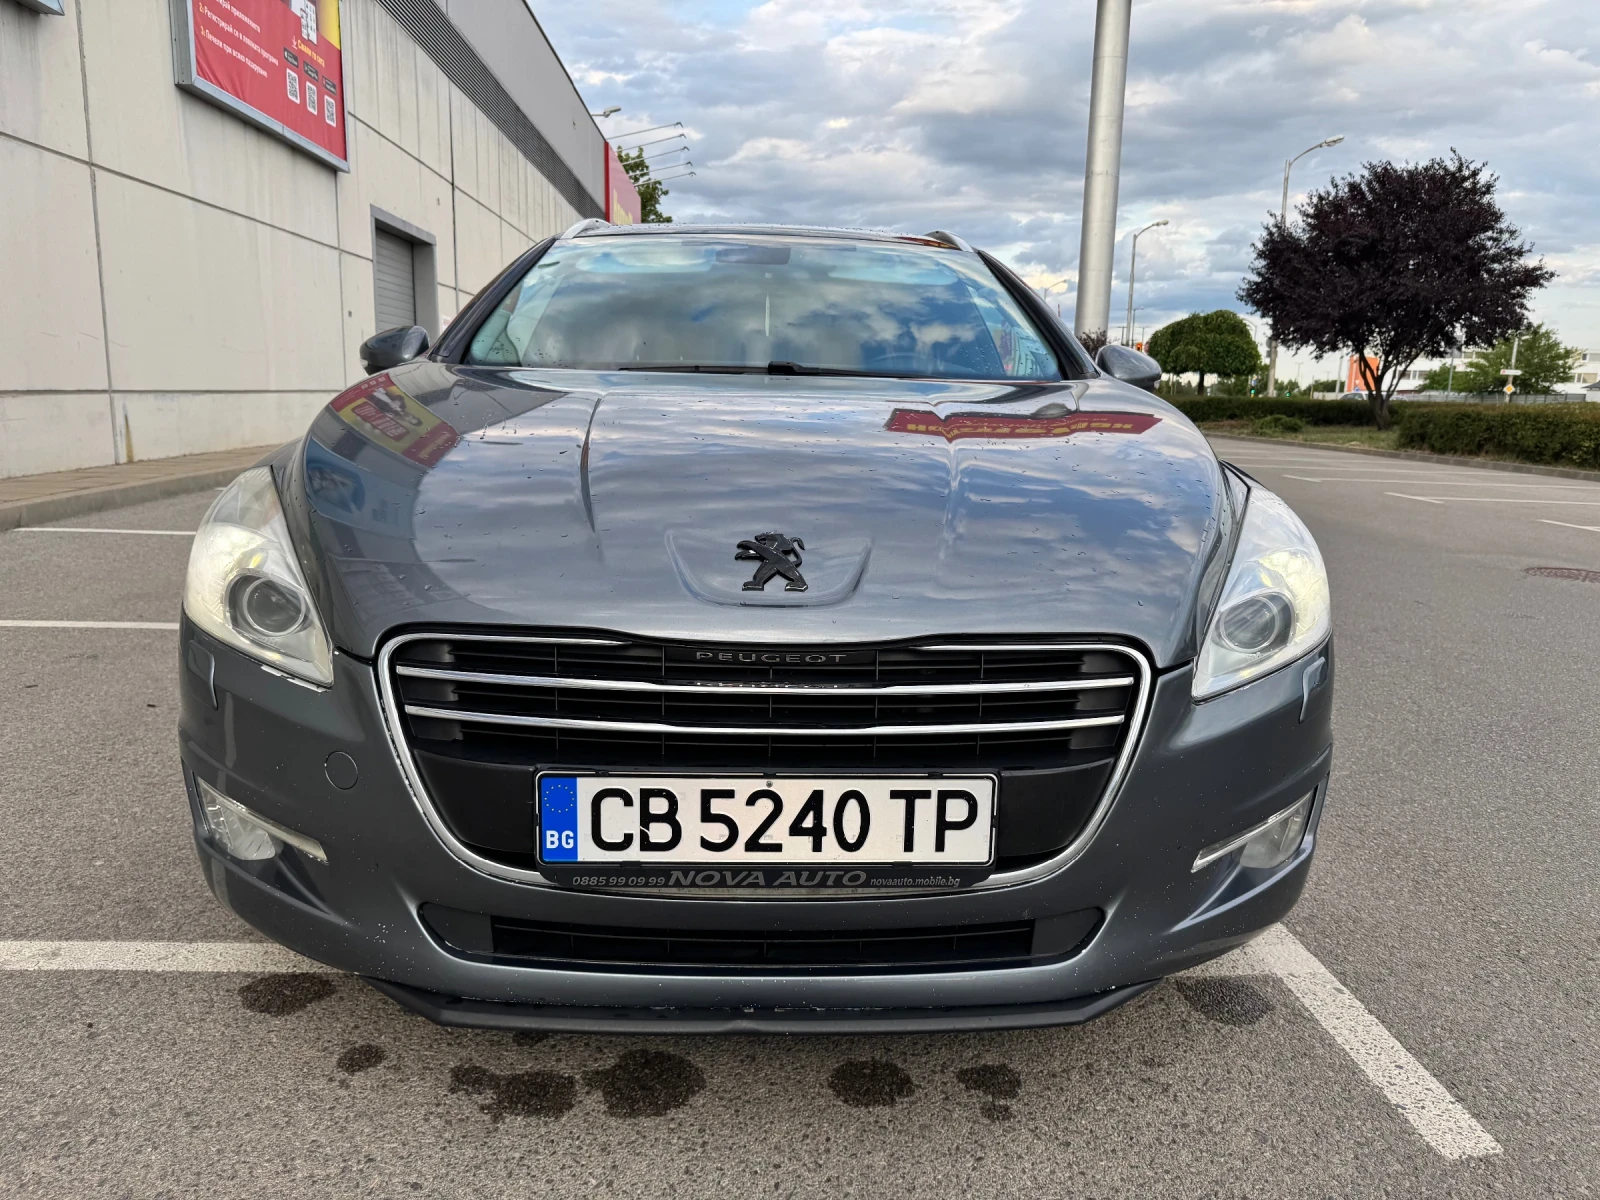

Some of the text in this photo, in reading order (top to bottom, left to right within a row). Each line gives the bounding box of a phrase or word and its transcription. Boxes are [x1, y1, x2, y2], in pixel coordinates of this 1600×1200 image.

[696, 651, 847, 663] PEUGEOT
[591, 787, 978, 852] CB 5240 TP
[545, 830, 574, 849] BG
[572, 870, 961, 888] 0885 99 09 99 NOVA AUTO novaauto.mobile.bg
